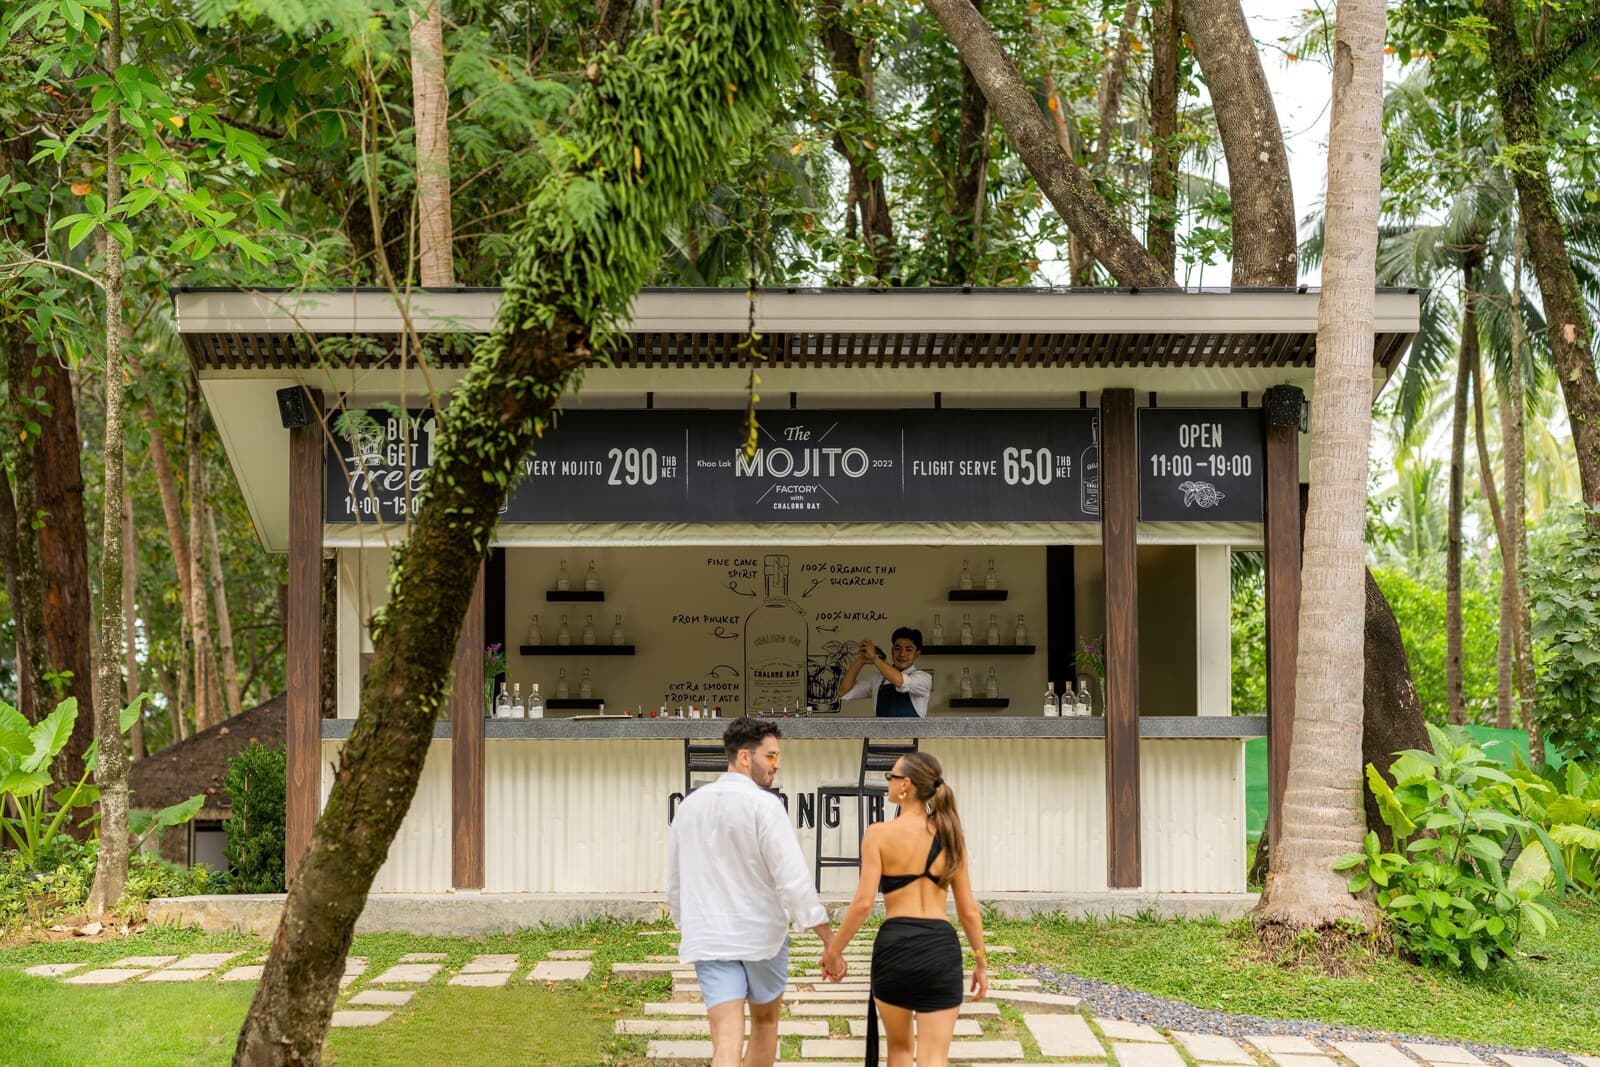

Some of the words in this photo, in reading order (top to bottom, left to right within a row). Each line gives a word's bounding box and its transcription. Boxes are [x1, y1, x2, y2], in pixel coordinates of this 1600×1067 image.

[387, 417, 421, 441] BUY
[784, 425, 811, 441] The
[1179, 423, 1222, 449] OPEN
[387, 443, 419, 466] GET
[661, 456, 677, 466] THB
[697, 460, 717, 468] Khao
[718, 460, 732, 468] Lak
[735, 447, 869, 478] MOJITO
[1056, 455, 1072, 466] THB
[562, 460, 602, 476] MOJITO
[607, 447, 658, 486] 290
[913, 460, 954, 476] FLIGHT
[959, 460, 997, 476] SERVE
[1003, 447, 1052, 486] 650
[661, 467, 677, 478] NET
[1056, 467, 1072, 478] NET
[776, 485, 818, 493] FACTORY
[707, 558, 729, 566] FINE
[733, 558, 758, 566] CANE
[728, 569, 758, 579] SPIRIT
[800, 562, 828, 573] 100%
[830, 563, 872, 575] ORGANIC
[875, 566, 896, 574] THAI
[830, 576, 885, 586] SUGARCANE
[672, 615, 700, 625] FROM
[703, 615, 740, 625] PHUKET
[815, 610, 842, 621] 100%
[843, 610, 888, 621] NATURAL
[669, 681, 699, 691] EXTRA
[702, 682, 739, 691] SMOOTH
[664, 693, 709, 703] TROPICAL
[712, 694, 739, 703] TASTE
